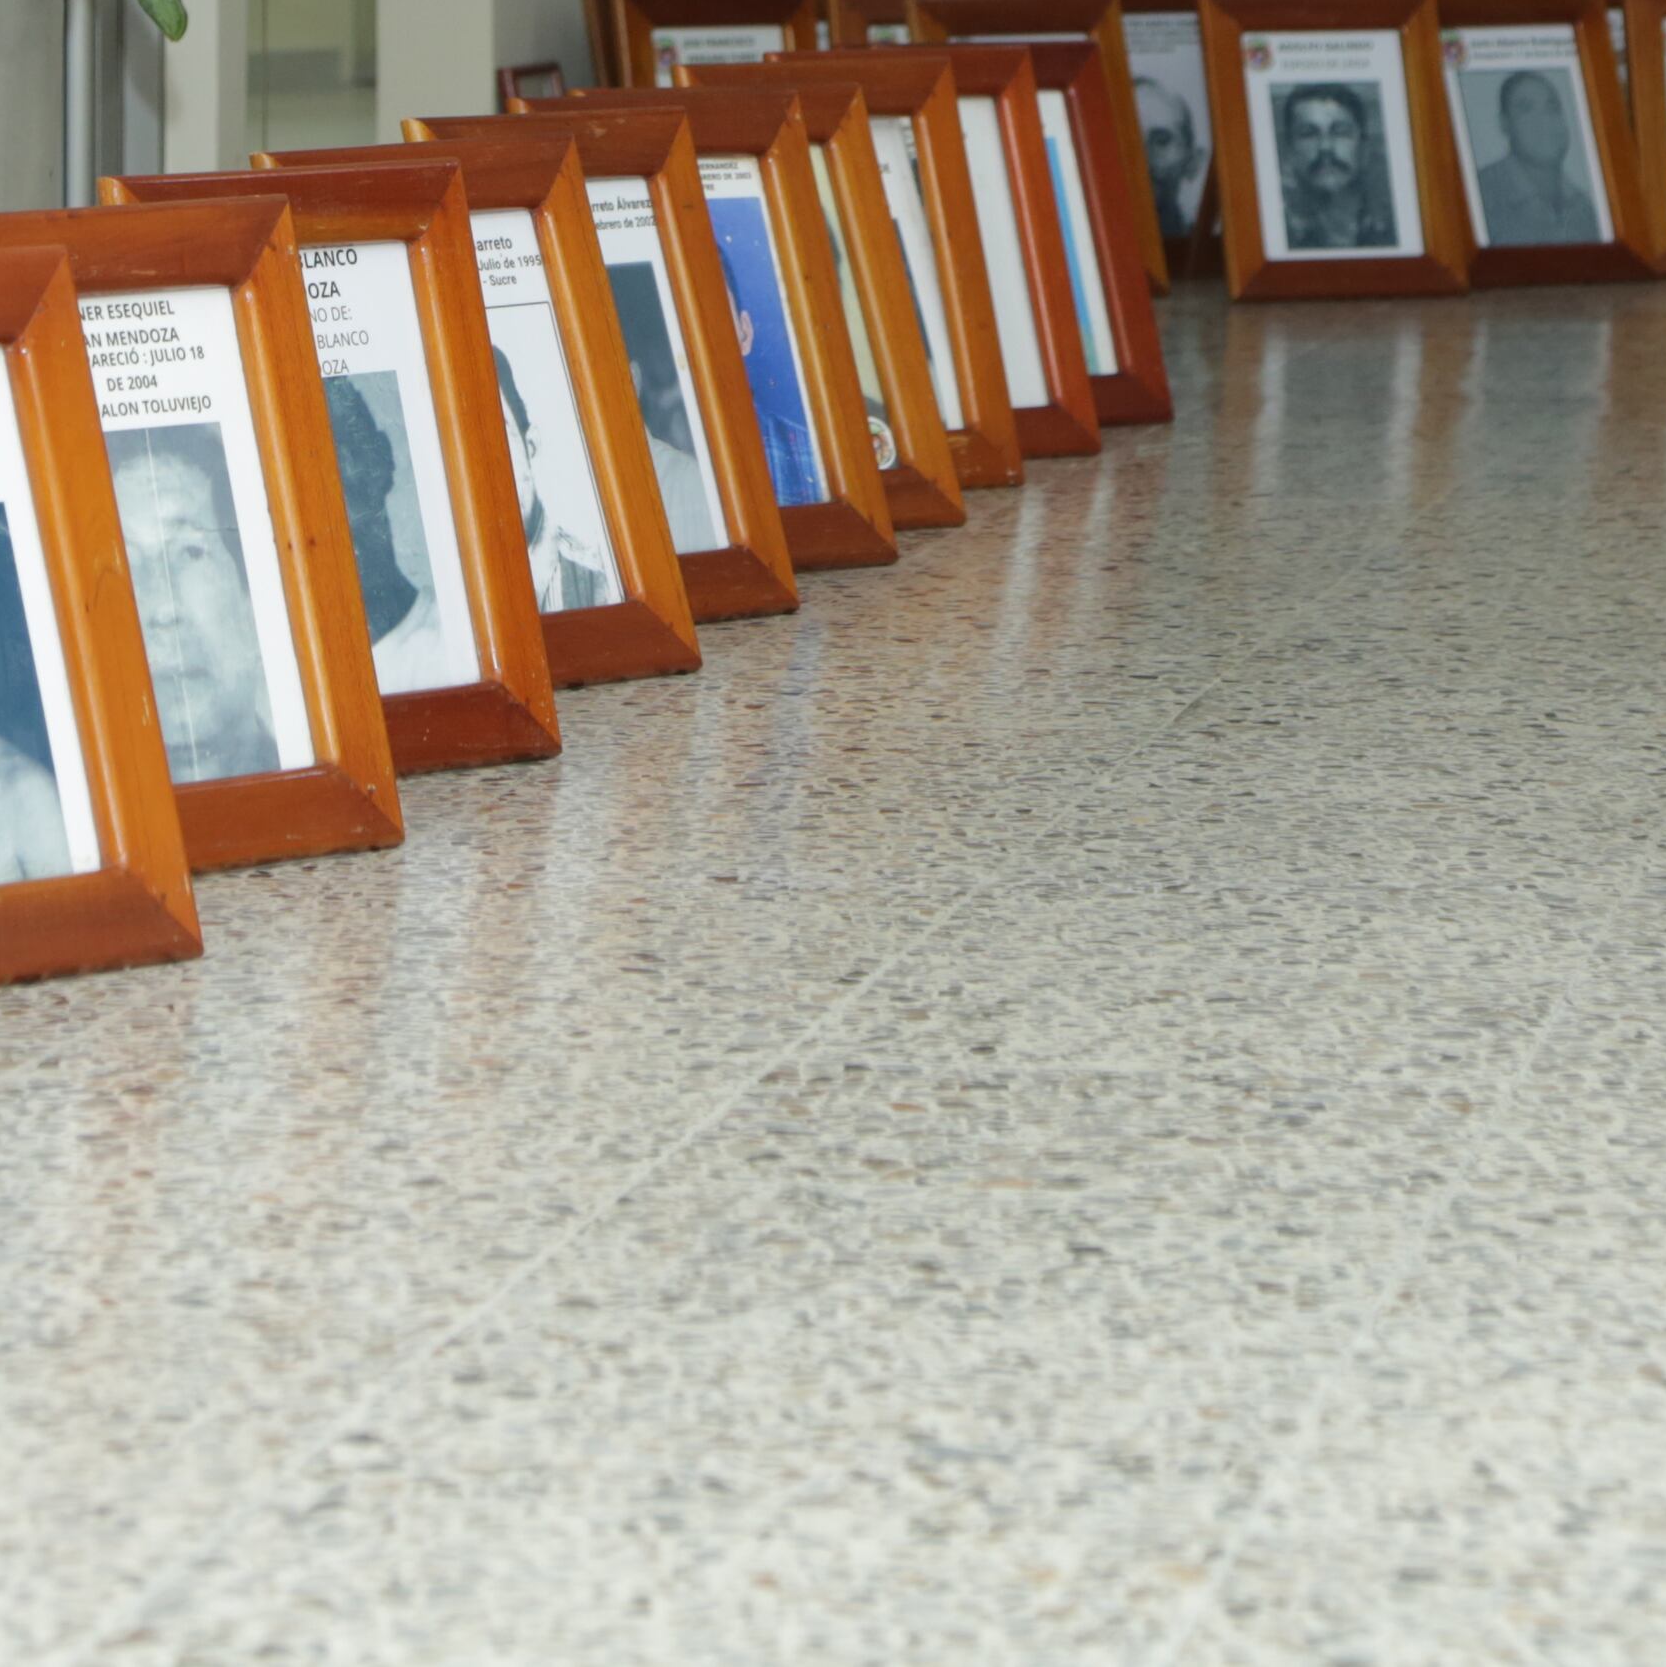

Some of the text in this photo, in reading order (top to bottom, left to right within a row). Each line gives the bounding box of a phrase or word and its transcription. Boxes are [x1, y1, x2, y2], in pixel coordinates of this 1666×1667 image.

[623, 217, 634, 229] de
[477, 254, 542, 272] Julio de 1995
[489, 274, 517, 287] Sucre
[307, 281, 341, 300] OZA
[106, 300, 175, 321] ESEQUIEL
[105, 327, 180, 348] MENDOZA
[316, 330, 370, 350] BLANCO
[149, 346, 187, 366] JULIO
[189, 345, 205, 360] 18
[321, 359, 350, 376] OZA
[106, 375, 158, 392] DE 2004
[101, 395, 213, 418] ALON TOLUVIEJO
